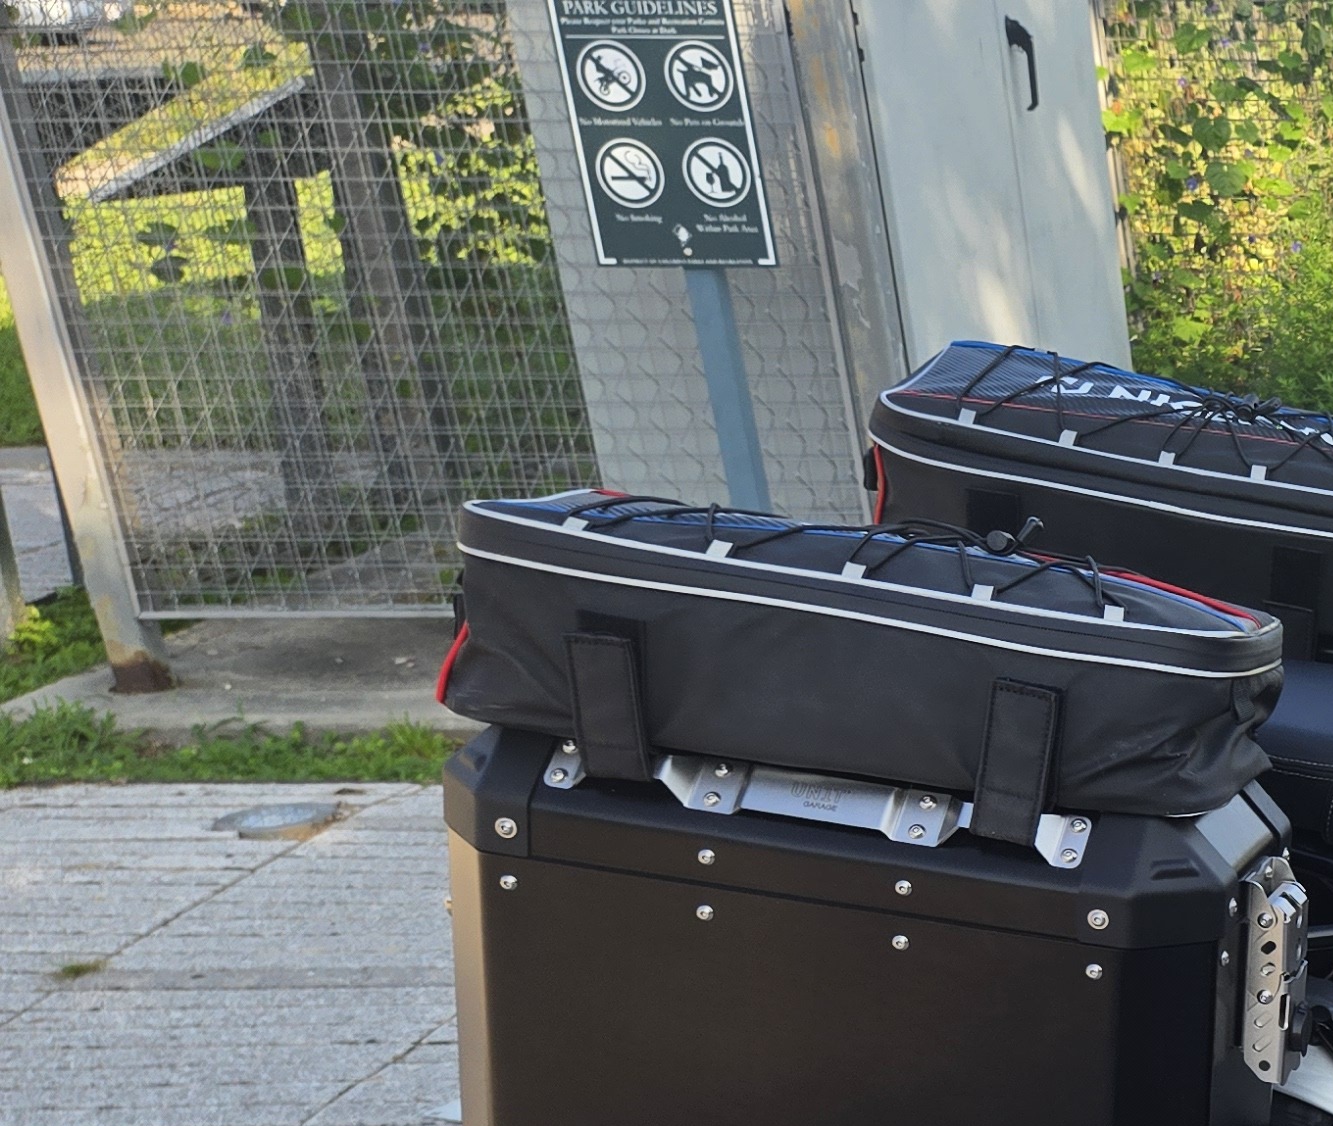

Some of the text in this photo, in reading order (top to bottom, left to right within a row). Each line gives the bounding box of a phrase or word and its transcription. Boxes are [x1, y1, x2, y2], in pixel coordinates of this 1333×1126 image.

[562, 0, 718, 15] PARK GUIDELINES
[615, 213, 630, 222] No
[703, 213, 718, 222] No
[802, 800, 838, 811] GARAGE
